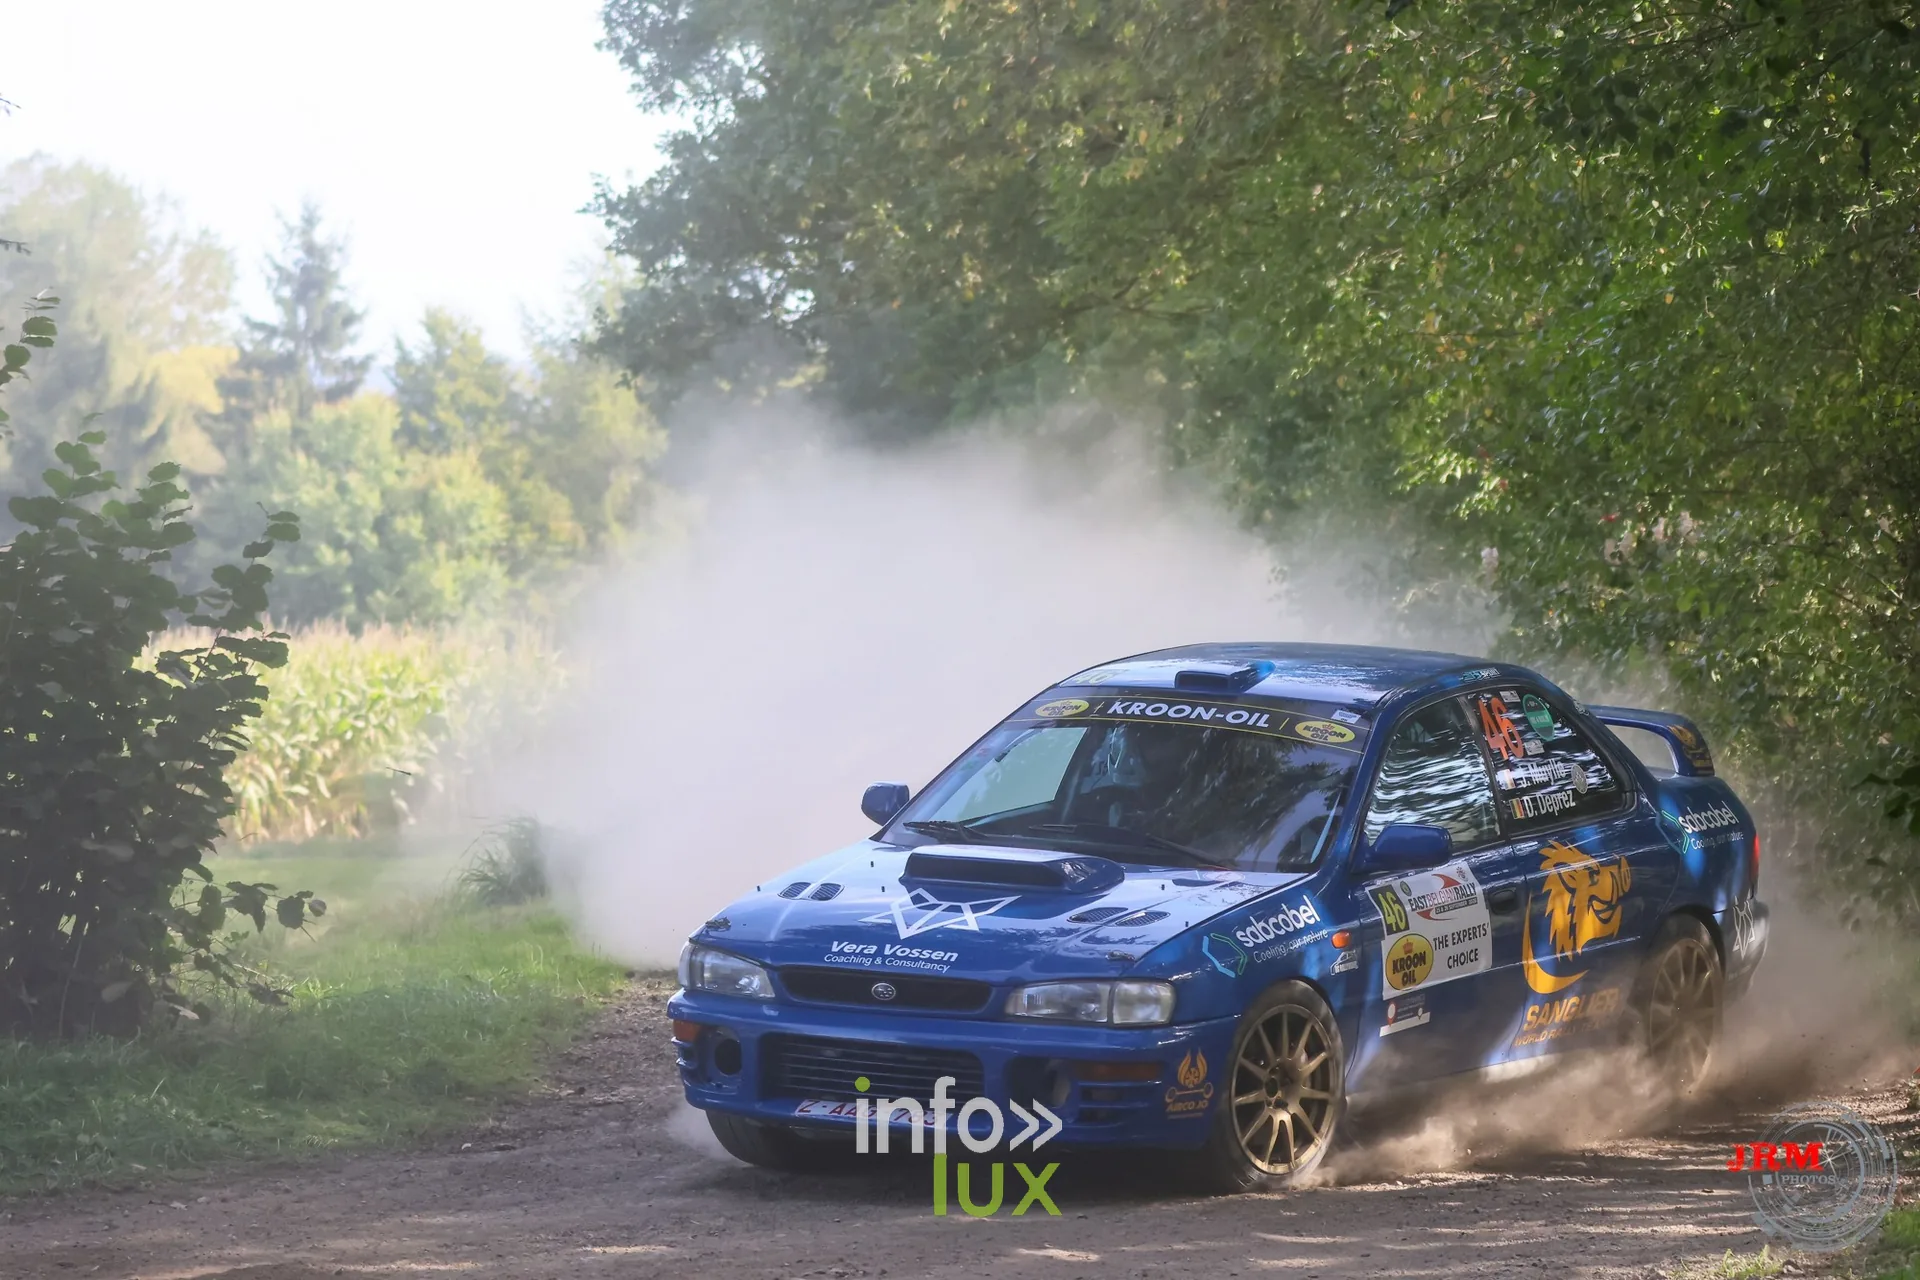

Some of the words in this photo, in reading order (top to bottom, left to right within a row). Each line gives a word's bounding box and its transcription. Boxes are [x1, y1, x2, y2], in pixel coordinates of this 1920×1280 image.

[1107, 701, 1269, 728] KROON-OIL
[1303, 724, 1347, 738] KROON
[1310, 733, 1329, 741] OIL
[1478, 697, 1524, 760] 46
[1521, 796, 1538, 818] D.
[1536, 789, 1576, 816] Deprez
[1678, 800, 1739, 834] sabcobel
[1236, 894, 1321, 947] sabcobel
[1378, 891, 1406, 931] 46
[831, 941, 878, 955] Vera
[883, 944, 959, 962] Vossen
[1433, 934, 1449, 951] THE
[824, 954, 872, 966] Coaching
[874, 957, 882, 965] &
[885, 957, 950, 974] Consultancy
[1392, 951, 1426, 974] KROON
[1447, 948, 1479, 969] CHOICE
[1401, 969, 1417, 986] OIL
